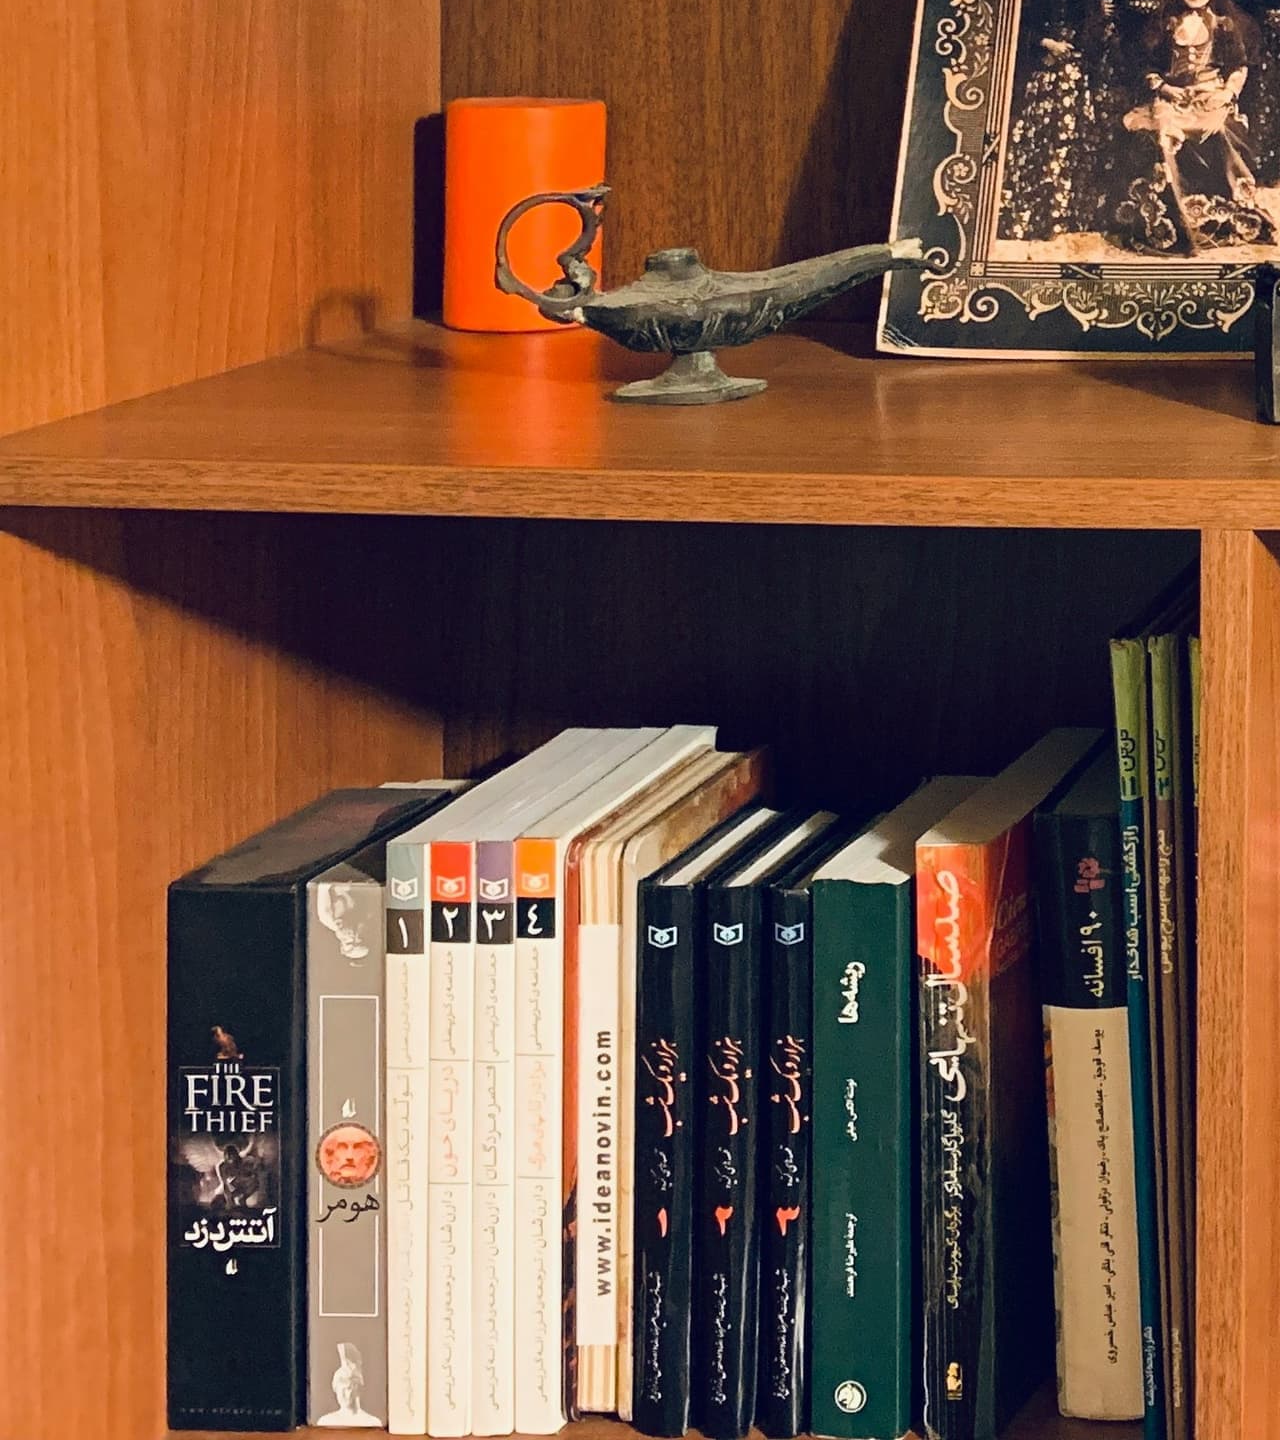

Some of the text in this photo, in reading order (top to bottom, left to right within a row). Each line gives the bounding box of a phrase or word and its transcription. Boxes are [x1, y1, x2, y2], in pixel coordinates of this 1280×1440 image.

[1080, 939, 1105, 998] افسانه
[184, 1073, 274, 1111] FIRE
[184, 1110, 274, 1133] THIEF
[592, 1030, 612, 1297] www.ideanovin.com
[315, 1193, 380, 1223] هومر
